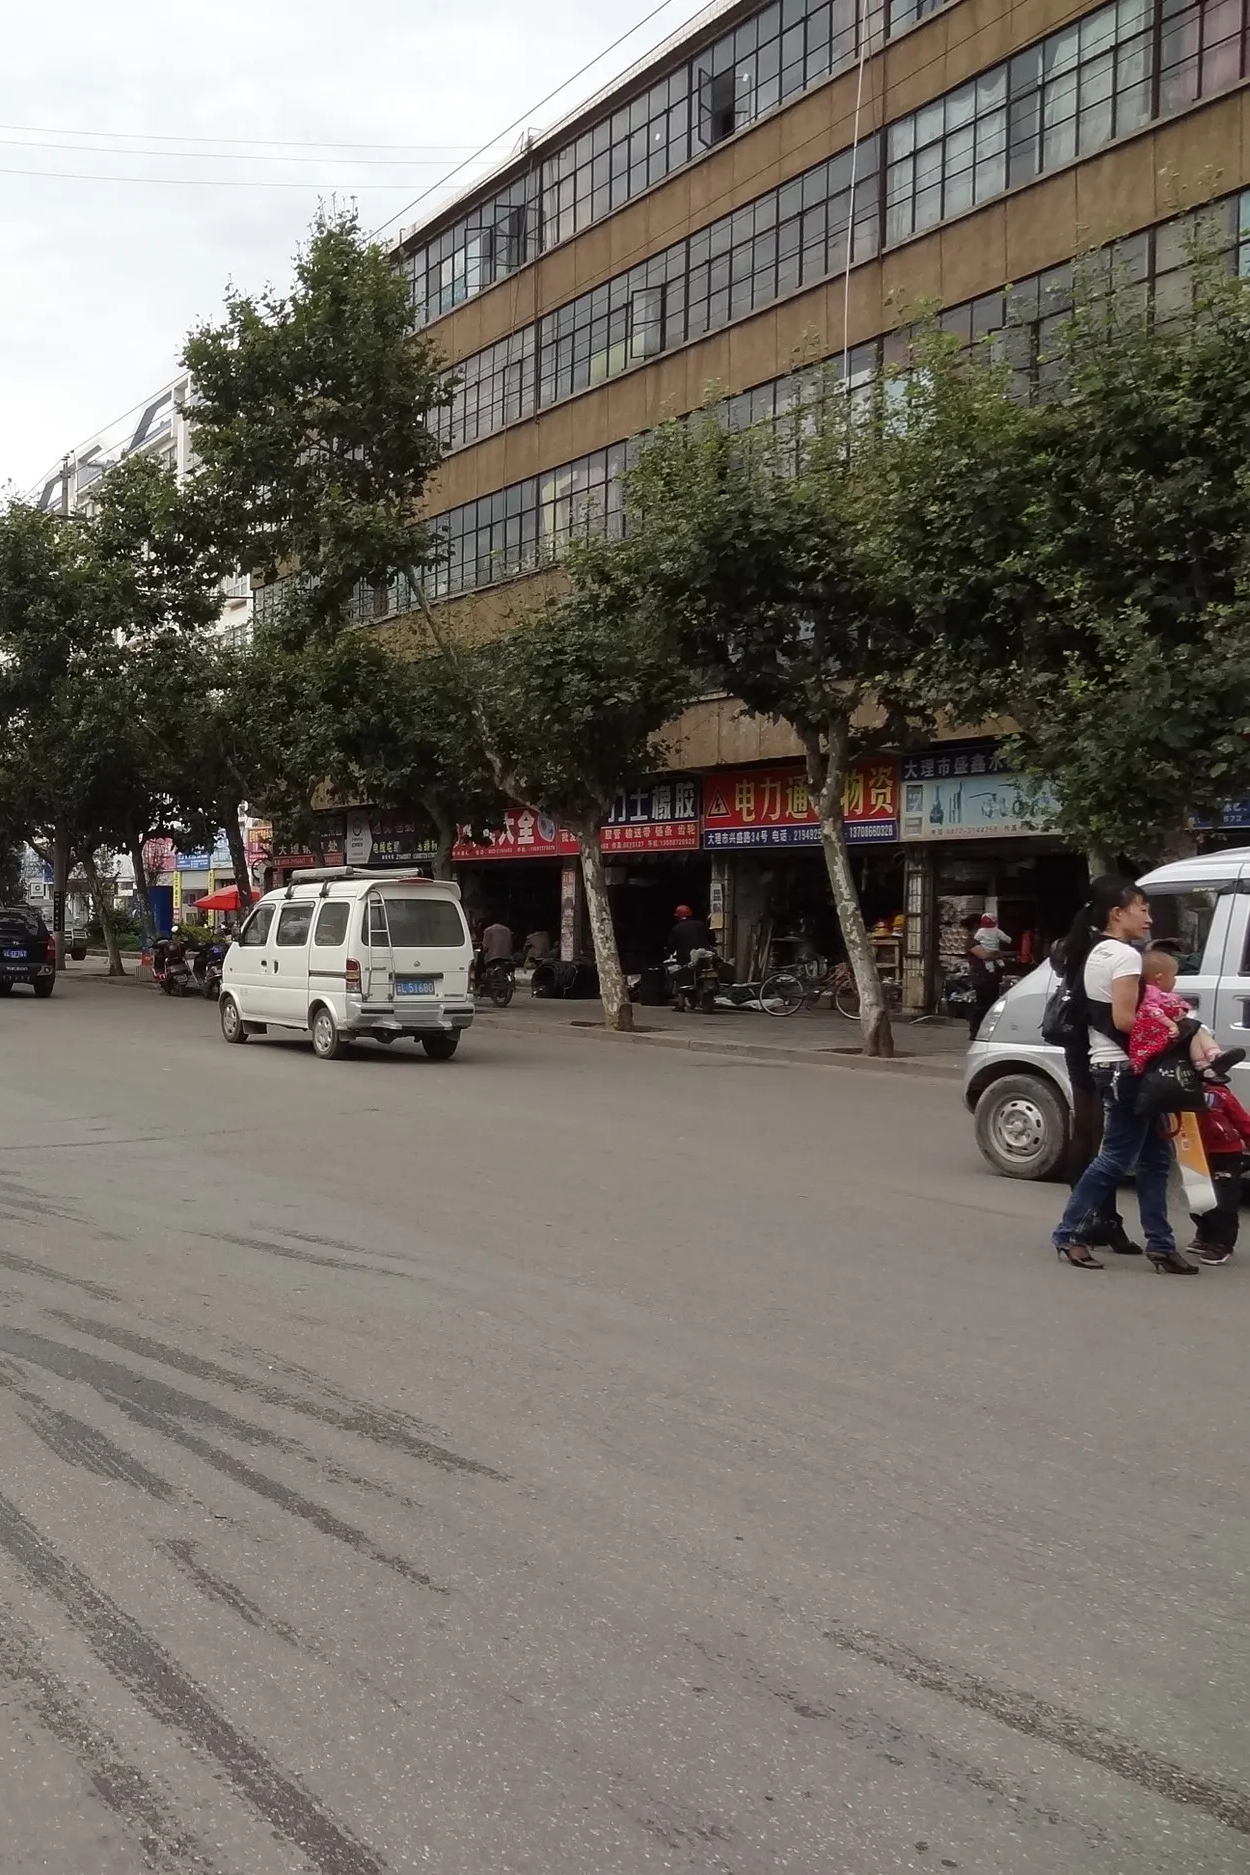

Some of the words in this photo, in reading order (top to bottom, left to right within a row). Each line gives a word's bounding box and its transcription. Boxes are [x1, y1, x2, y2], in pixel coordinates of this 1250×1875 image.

[735, 766, 895, 822] 电力通物资
